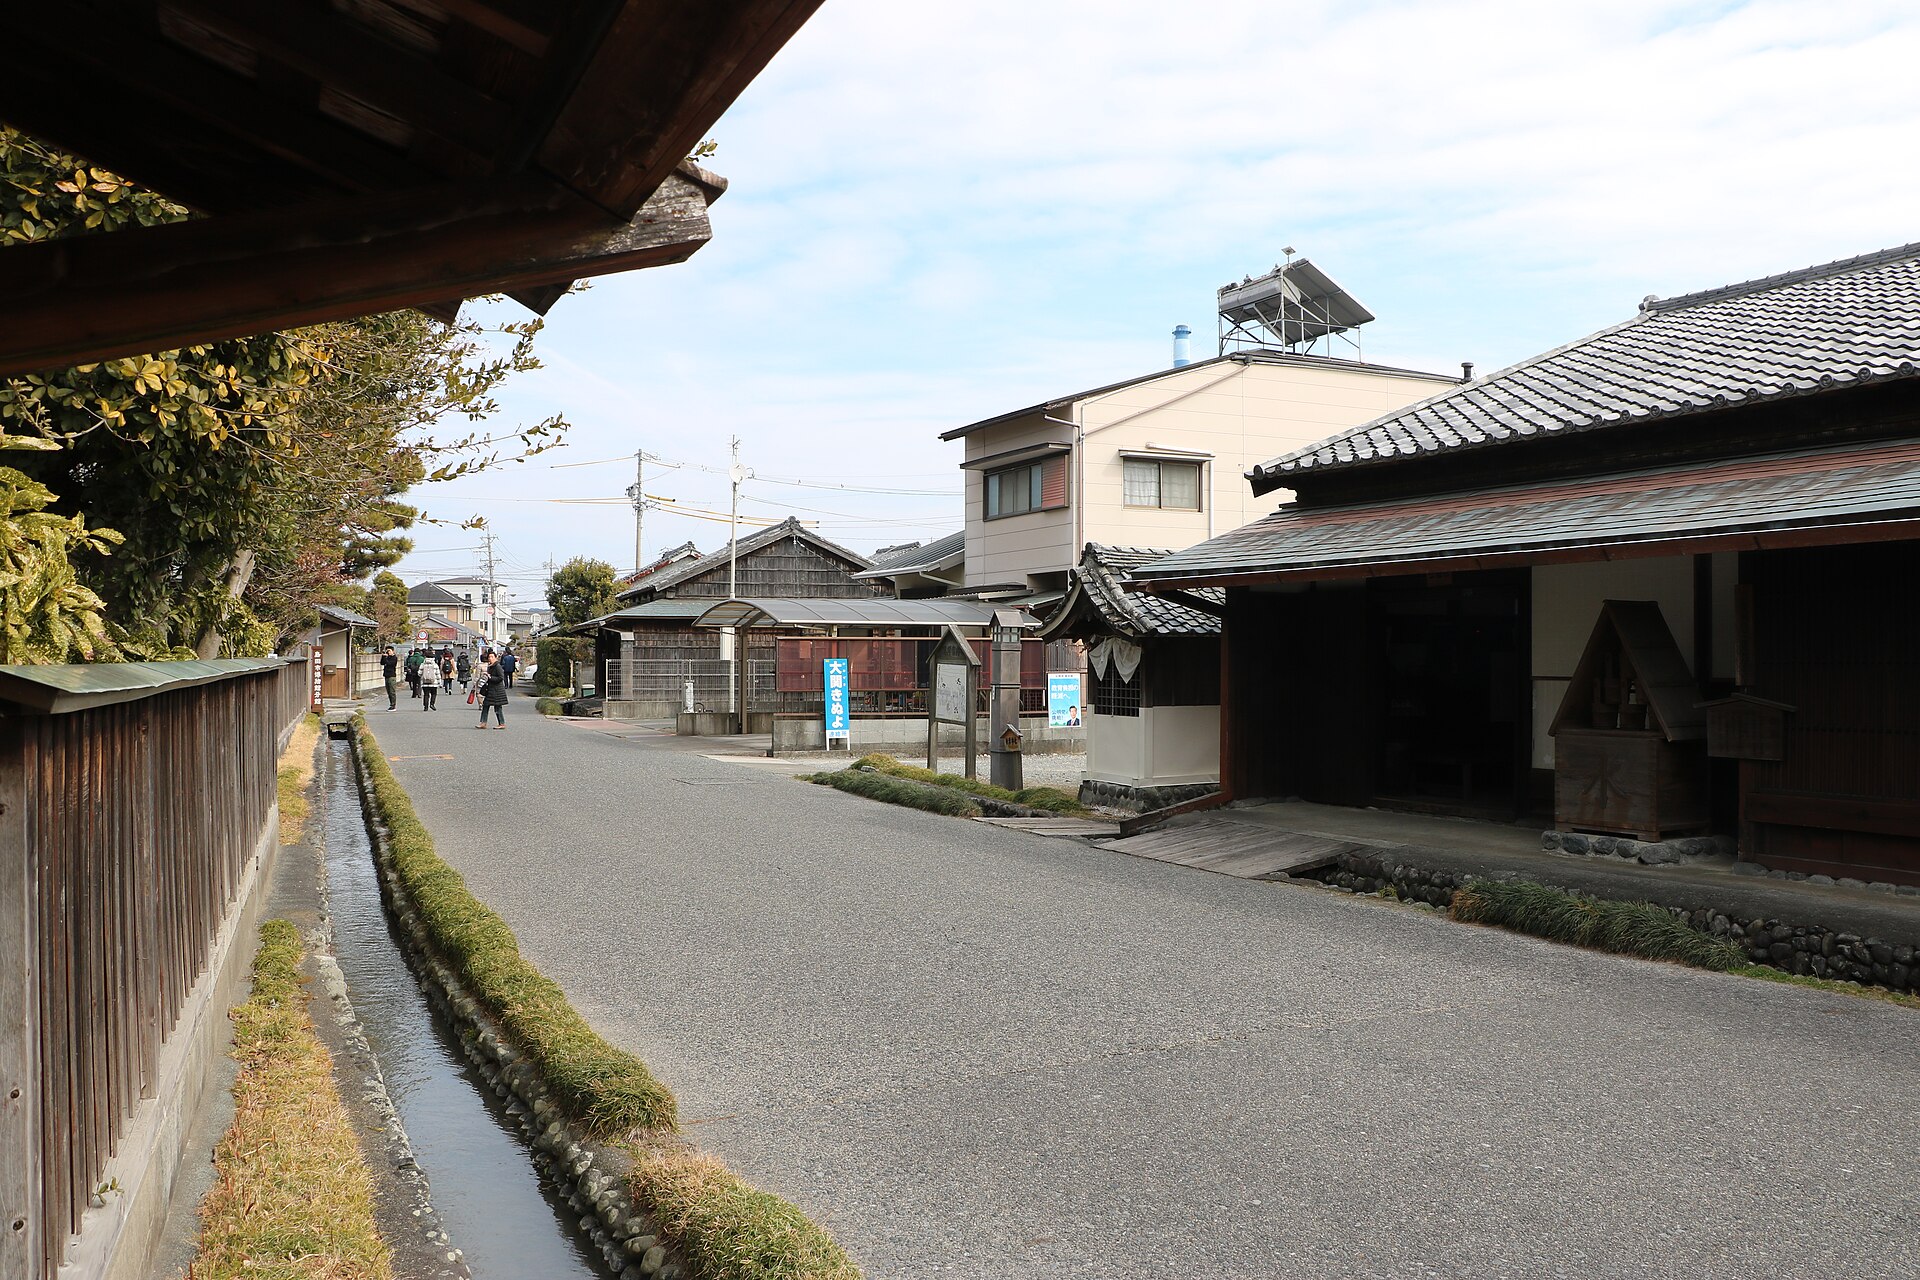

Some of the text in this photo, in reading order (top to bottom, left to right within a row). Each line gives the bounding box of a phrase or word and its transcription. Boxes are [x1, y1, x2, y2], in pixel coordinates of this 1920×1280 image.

[829, 661, 844, 729] 大関きぬよ
